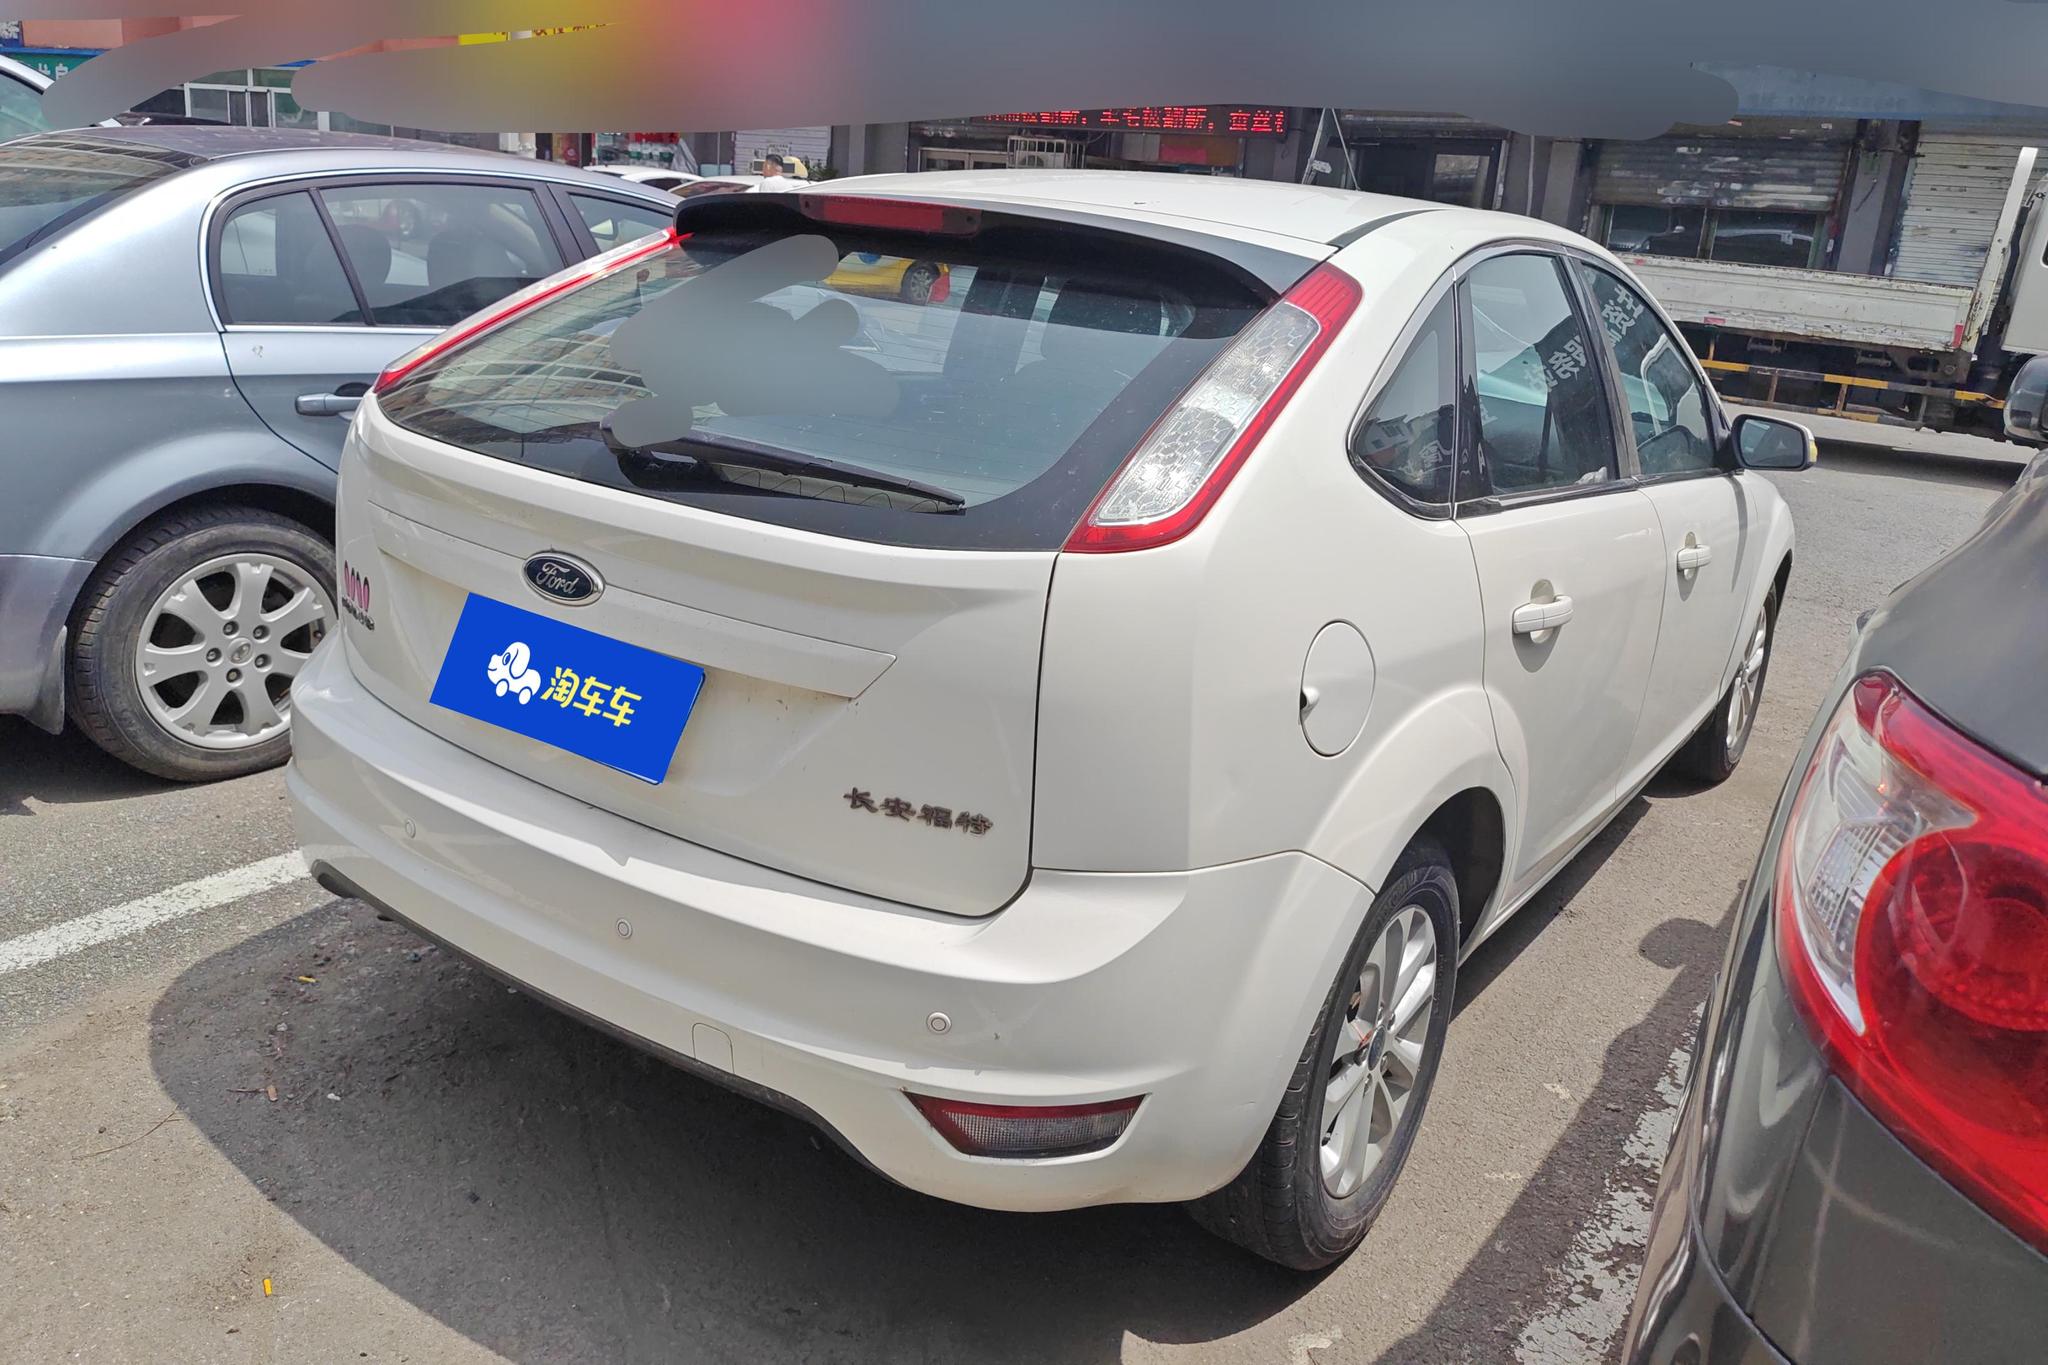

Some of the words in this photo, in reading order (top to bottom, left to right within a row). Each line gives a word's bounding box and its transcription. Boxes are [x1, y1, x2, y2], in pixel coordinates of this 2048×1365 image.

[536, 562, 579, 593] Ford
[843, 787, 993, 836] 长安福特
